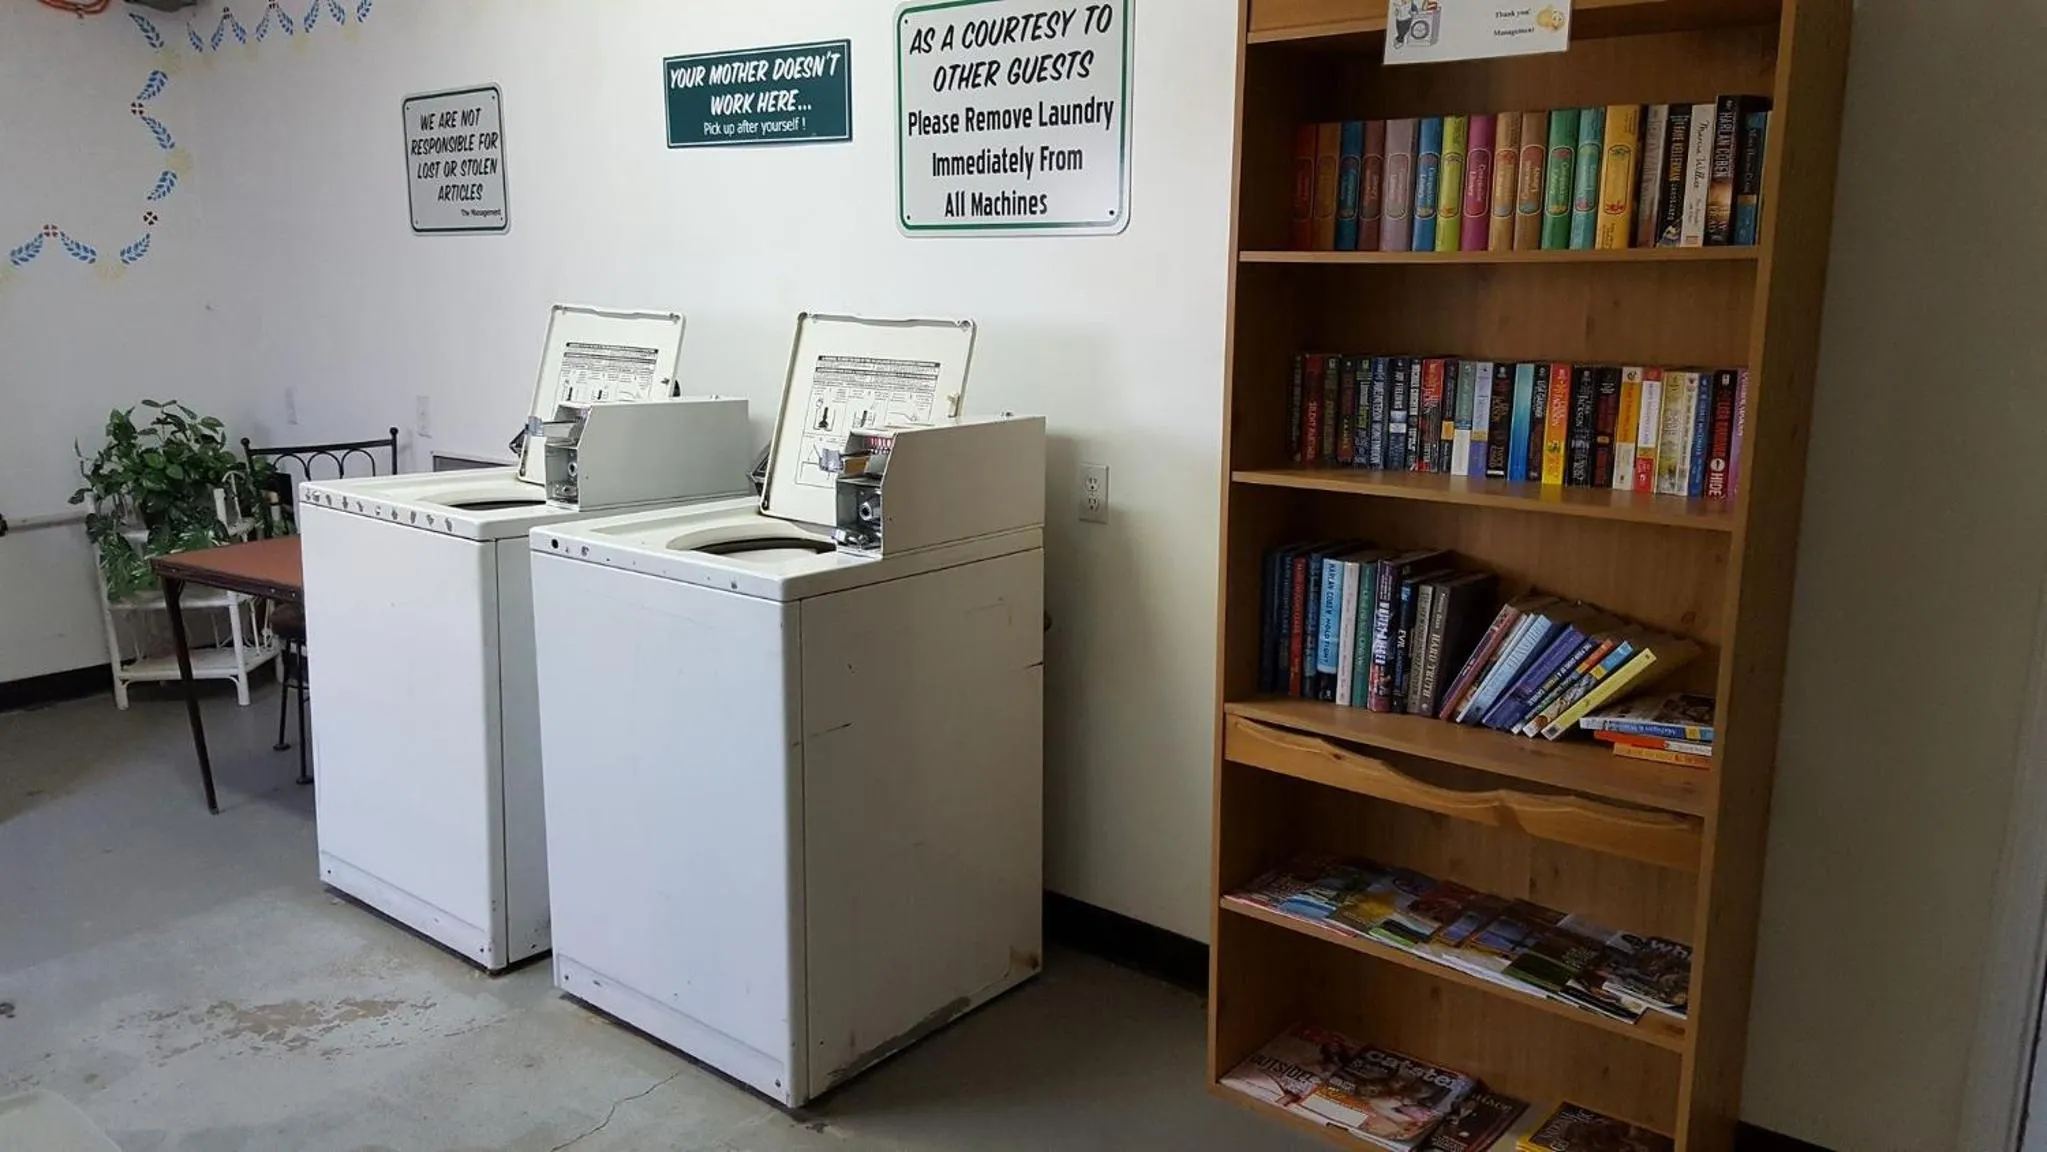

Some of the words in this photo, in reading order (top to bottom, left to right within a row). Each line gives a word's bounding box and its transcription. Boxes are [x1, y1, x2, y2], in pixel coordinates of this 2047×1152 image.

[909, 27, 935, 54] AS
[941, 24, 954, 51] A
[962, 8, 1077, 49] COURTESY
[1084, 4, 1112, 34] TO
[670, 65, 706, 89] YOUR
[708, 59, 769, 85] MOTHER
[772, 50, 841, 81] DOESN'T
[933, 60, 1001, 92] OTHER
[1007, 50, 1094, 85] GUESTS
[711, 92, 752, 116] WORK
[757, 89, 812, 113] HERE...
[908, 110, 960, 136] Please
[965, 106, 1033, 132] Remove
[1039, 96, 1114, 131] Laundry
[420, 113, 436, 131] WE
[439, 110, 458, 129] ARE
[460, 107, 482, 126] NOT
[703, 122, 722, 136] Pick
[723, 123, 735, 137] up
[737, 120, 759, 134] after
[761, 117, 800, 135] yourself
[1717, 112, 1734, 145] HARLAN
[411, 134, 475, 156] RESPONSIBLE
[478, 132, 499, 151] FOR
[417, 161, 440, 179] LOST
[443, 160, 457, 178] OR
[460, 158, 498, 177] STOLEN
[932, 146, 1034, 180] Immediately
[1040, 146, 1083, 172] From
[437, 183, 484, 202] ARTICLES
[945, 191, 965, 217] All
[971, 190, 1048, 216] Machines
[1708, 472, 1724, 496] HIDE
[1422, 664, 1436, 698] TRUTH
